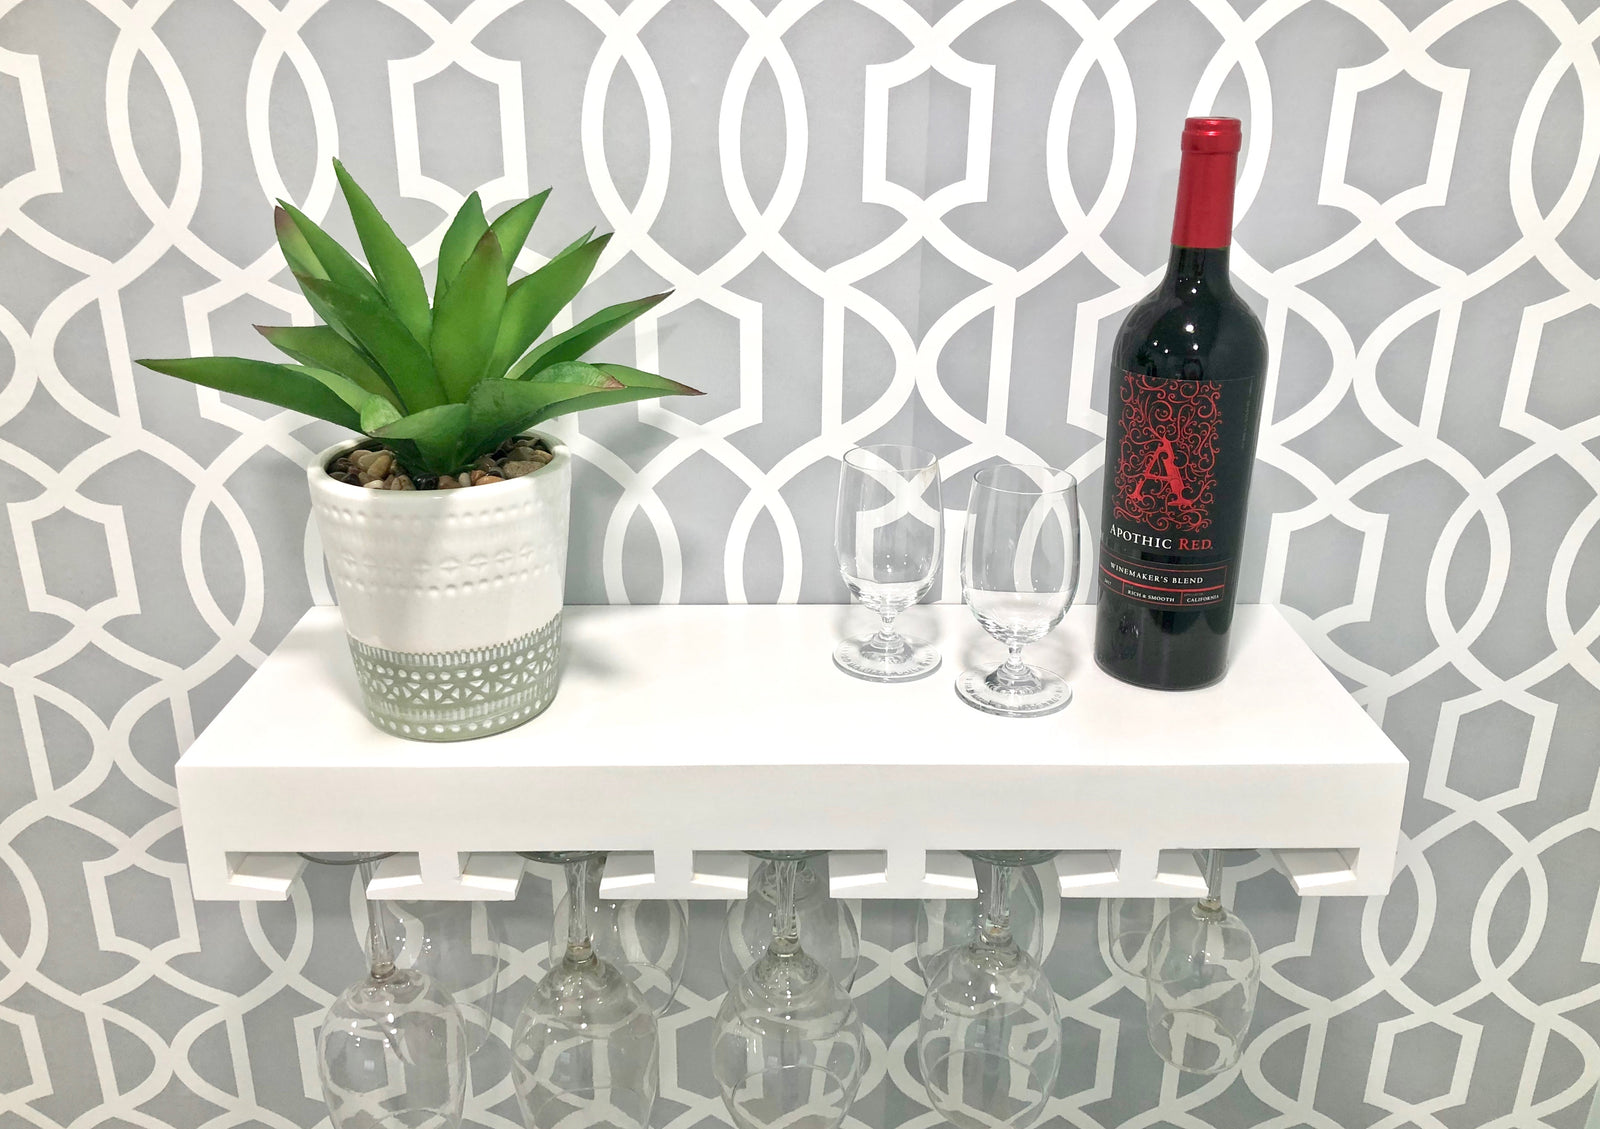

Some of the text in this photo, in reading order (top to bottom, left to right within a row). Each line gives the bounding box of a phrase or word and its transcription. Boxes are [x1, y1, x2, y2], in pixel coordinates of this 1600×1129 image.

[1109, 524, 1212, 551] APOTHIC RED
[1110, 561, 1168, 584] WINEMAKER'S
[1127, 589, 1141, 598] RICH
[1147, 594, 1175, 603] SMOOTH
[1186, 594, 1219, 603] CALIFORNIA
